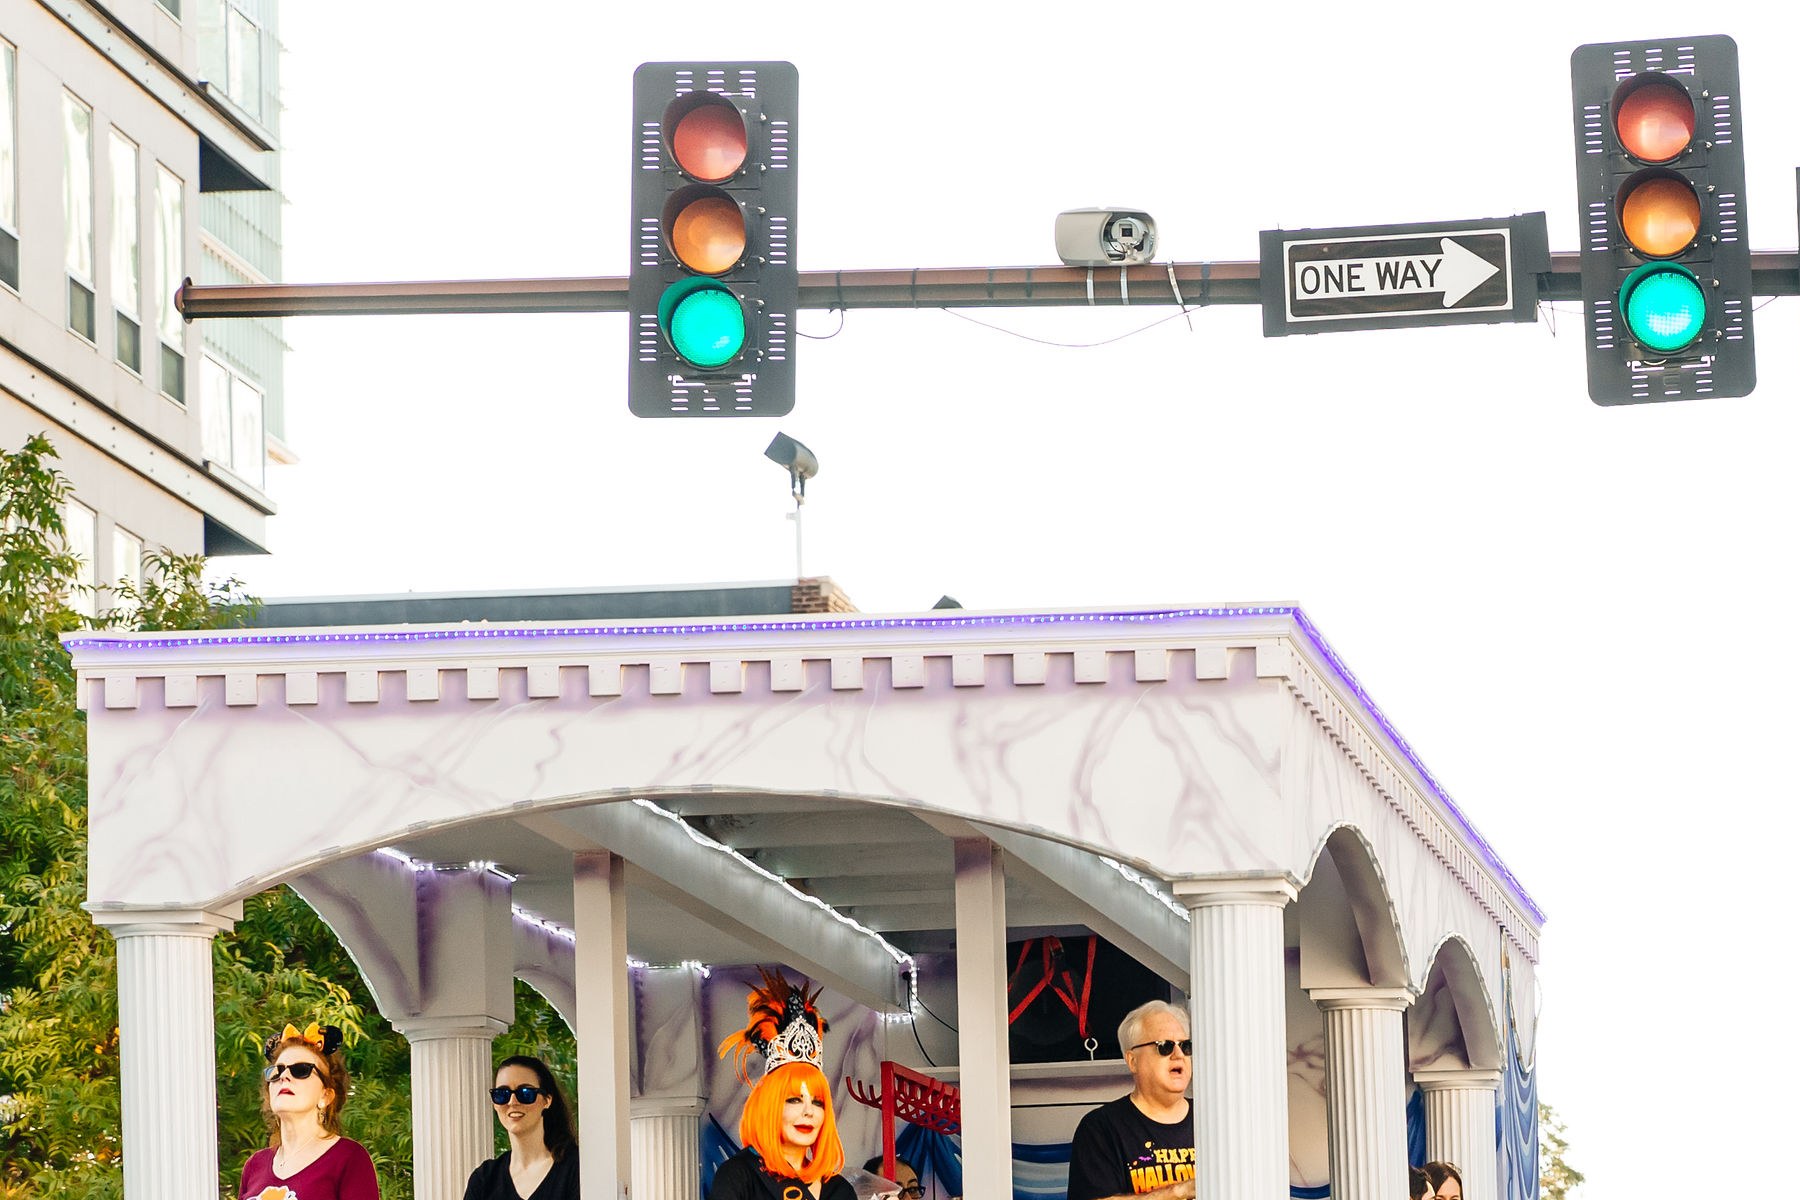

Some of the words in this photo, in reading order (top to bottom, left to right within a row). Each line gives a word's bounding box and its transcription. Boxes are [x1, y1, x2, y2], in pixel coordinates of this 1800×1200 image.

[1300, 263, 1365, 294] ONE
[1375, 259, 1442, 290] WAY
[1153, 1147, 1196, 1163] HAPP
